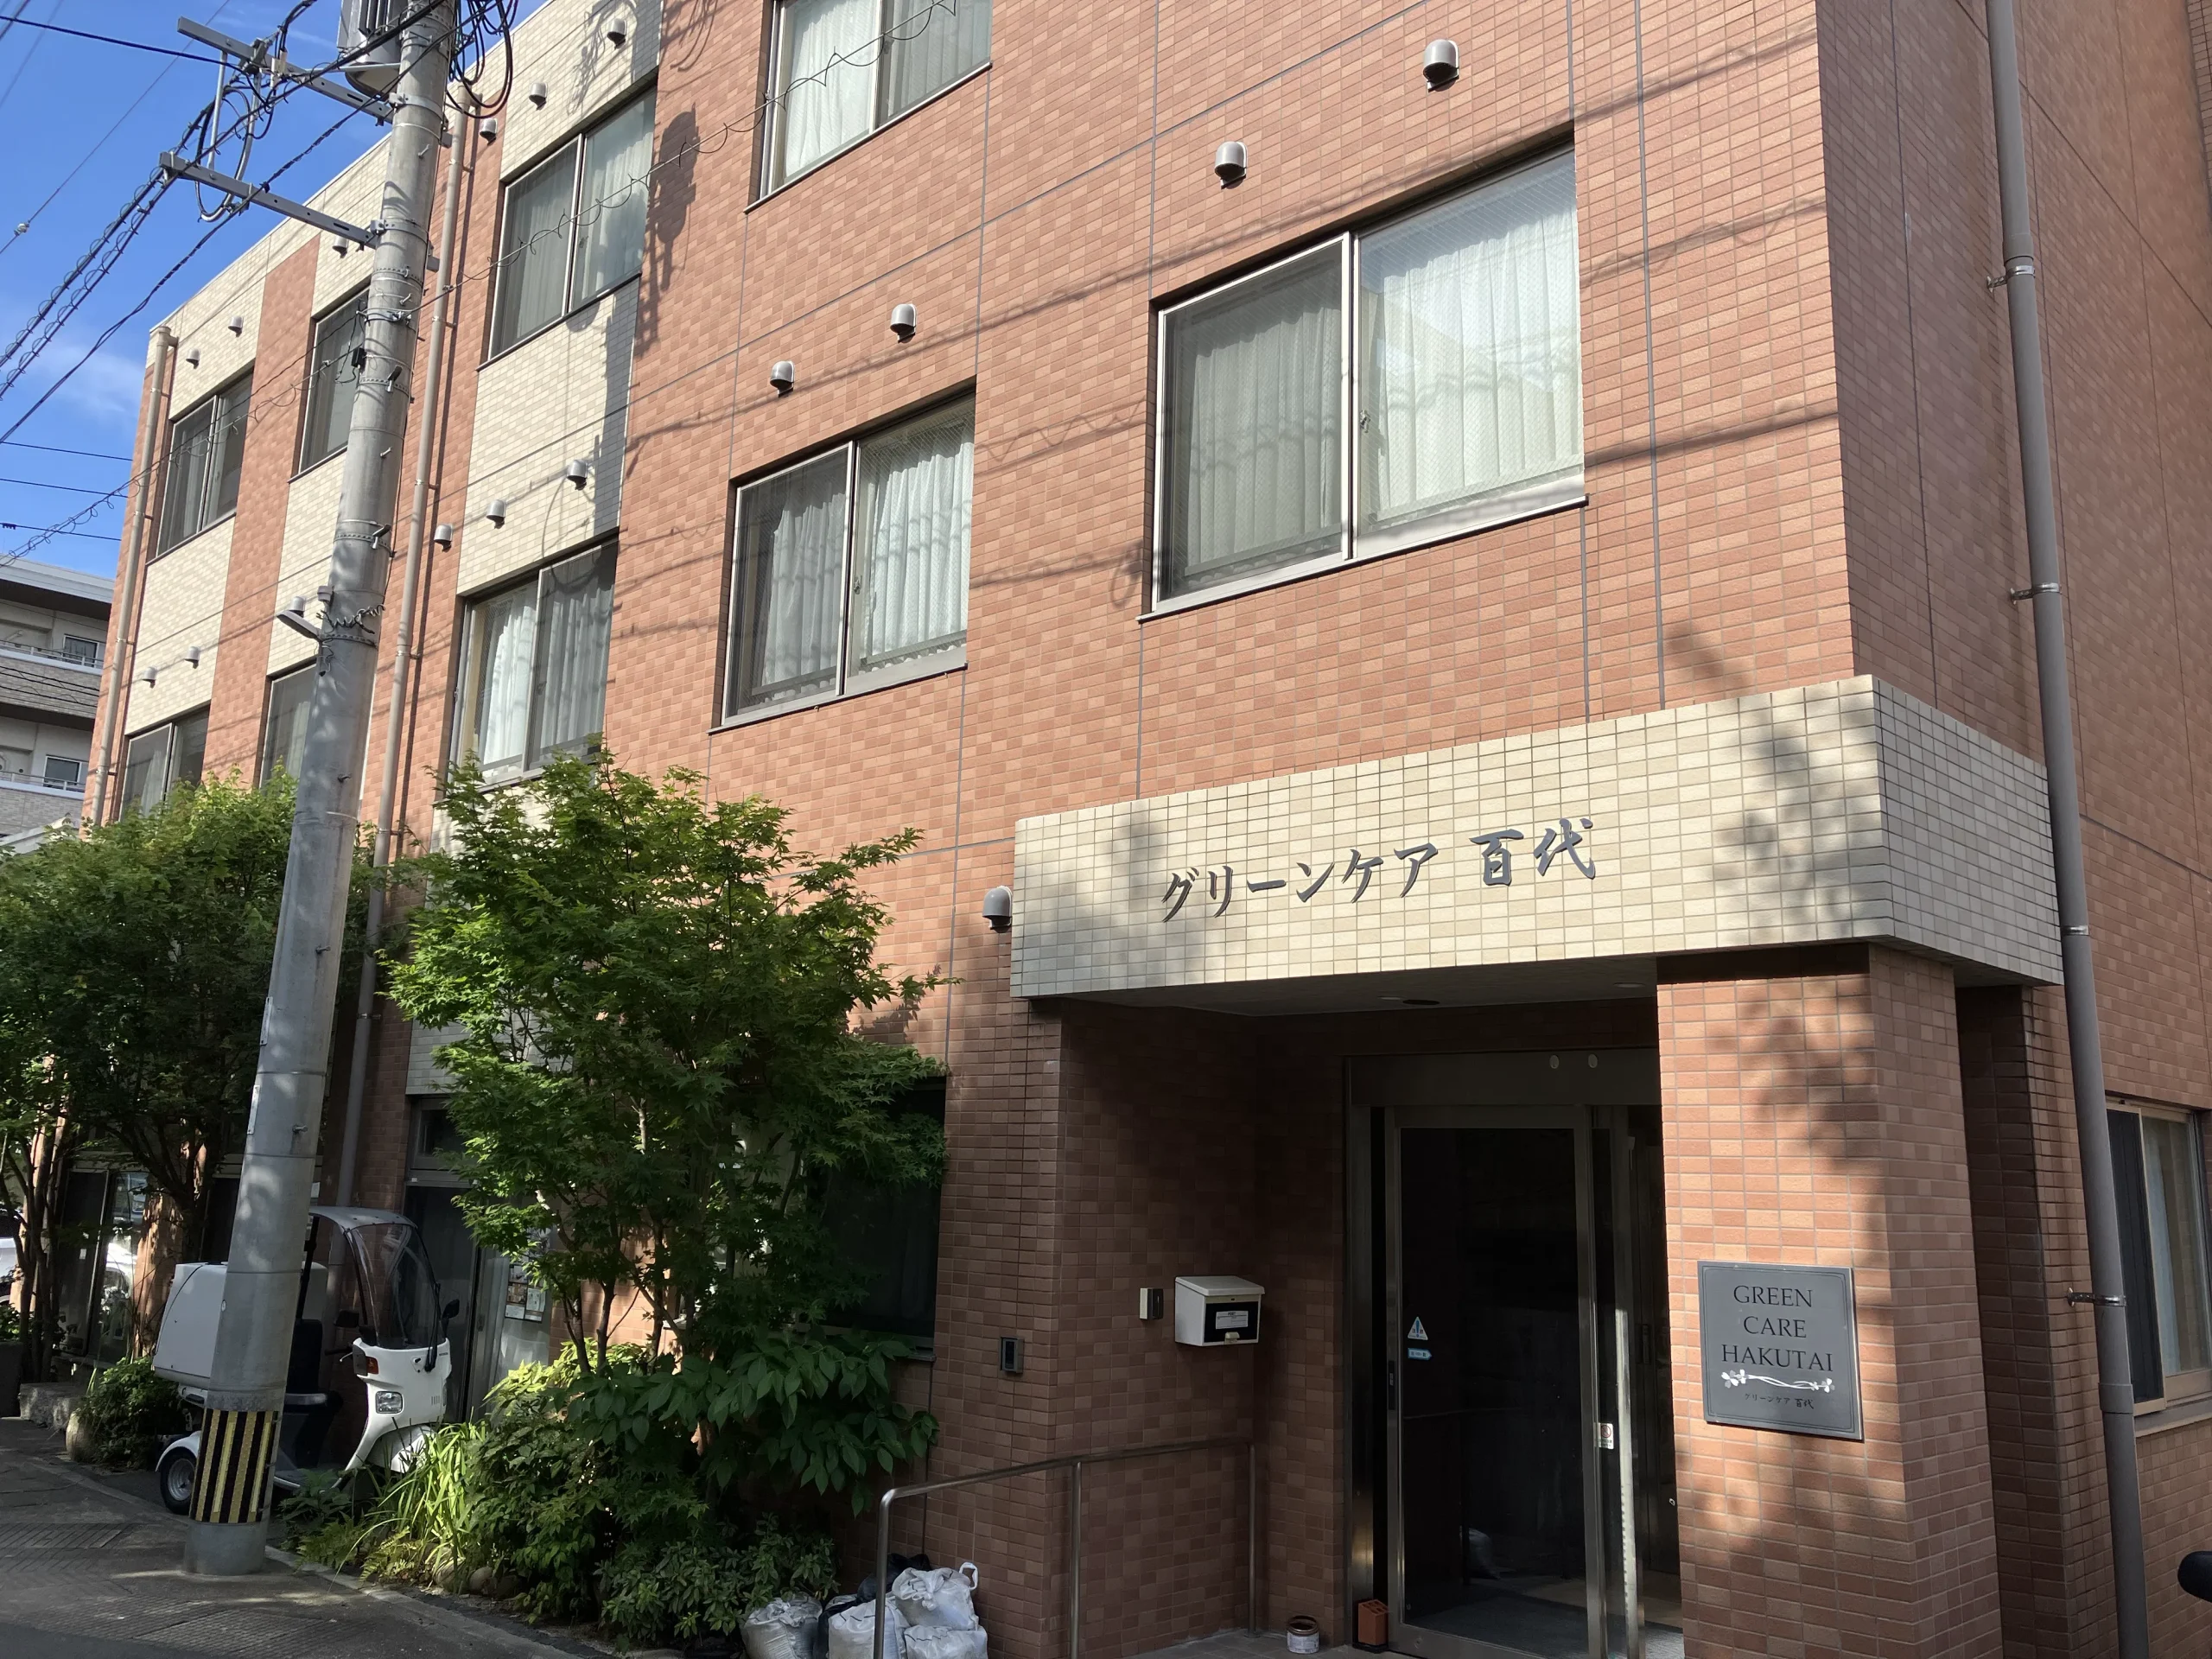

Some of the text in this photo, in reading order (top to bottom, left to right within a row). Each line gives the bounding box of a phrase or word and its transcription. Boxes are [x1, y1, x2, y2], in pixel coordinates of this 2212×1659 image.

[1161, 817, 1596, 923] グリーンケア 百代
[1733, 1285, 1812, 1307] GREEN
[1744, 1316, 1807, 1338] CARE
[1722, 1344, 1834, 1372] HAKUTAI
[1795, 1398, 1815, 1409] 百代
